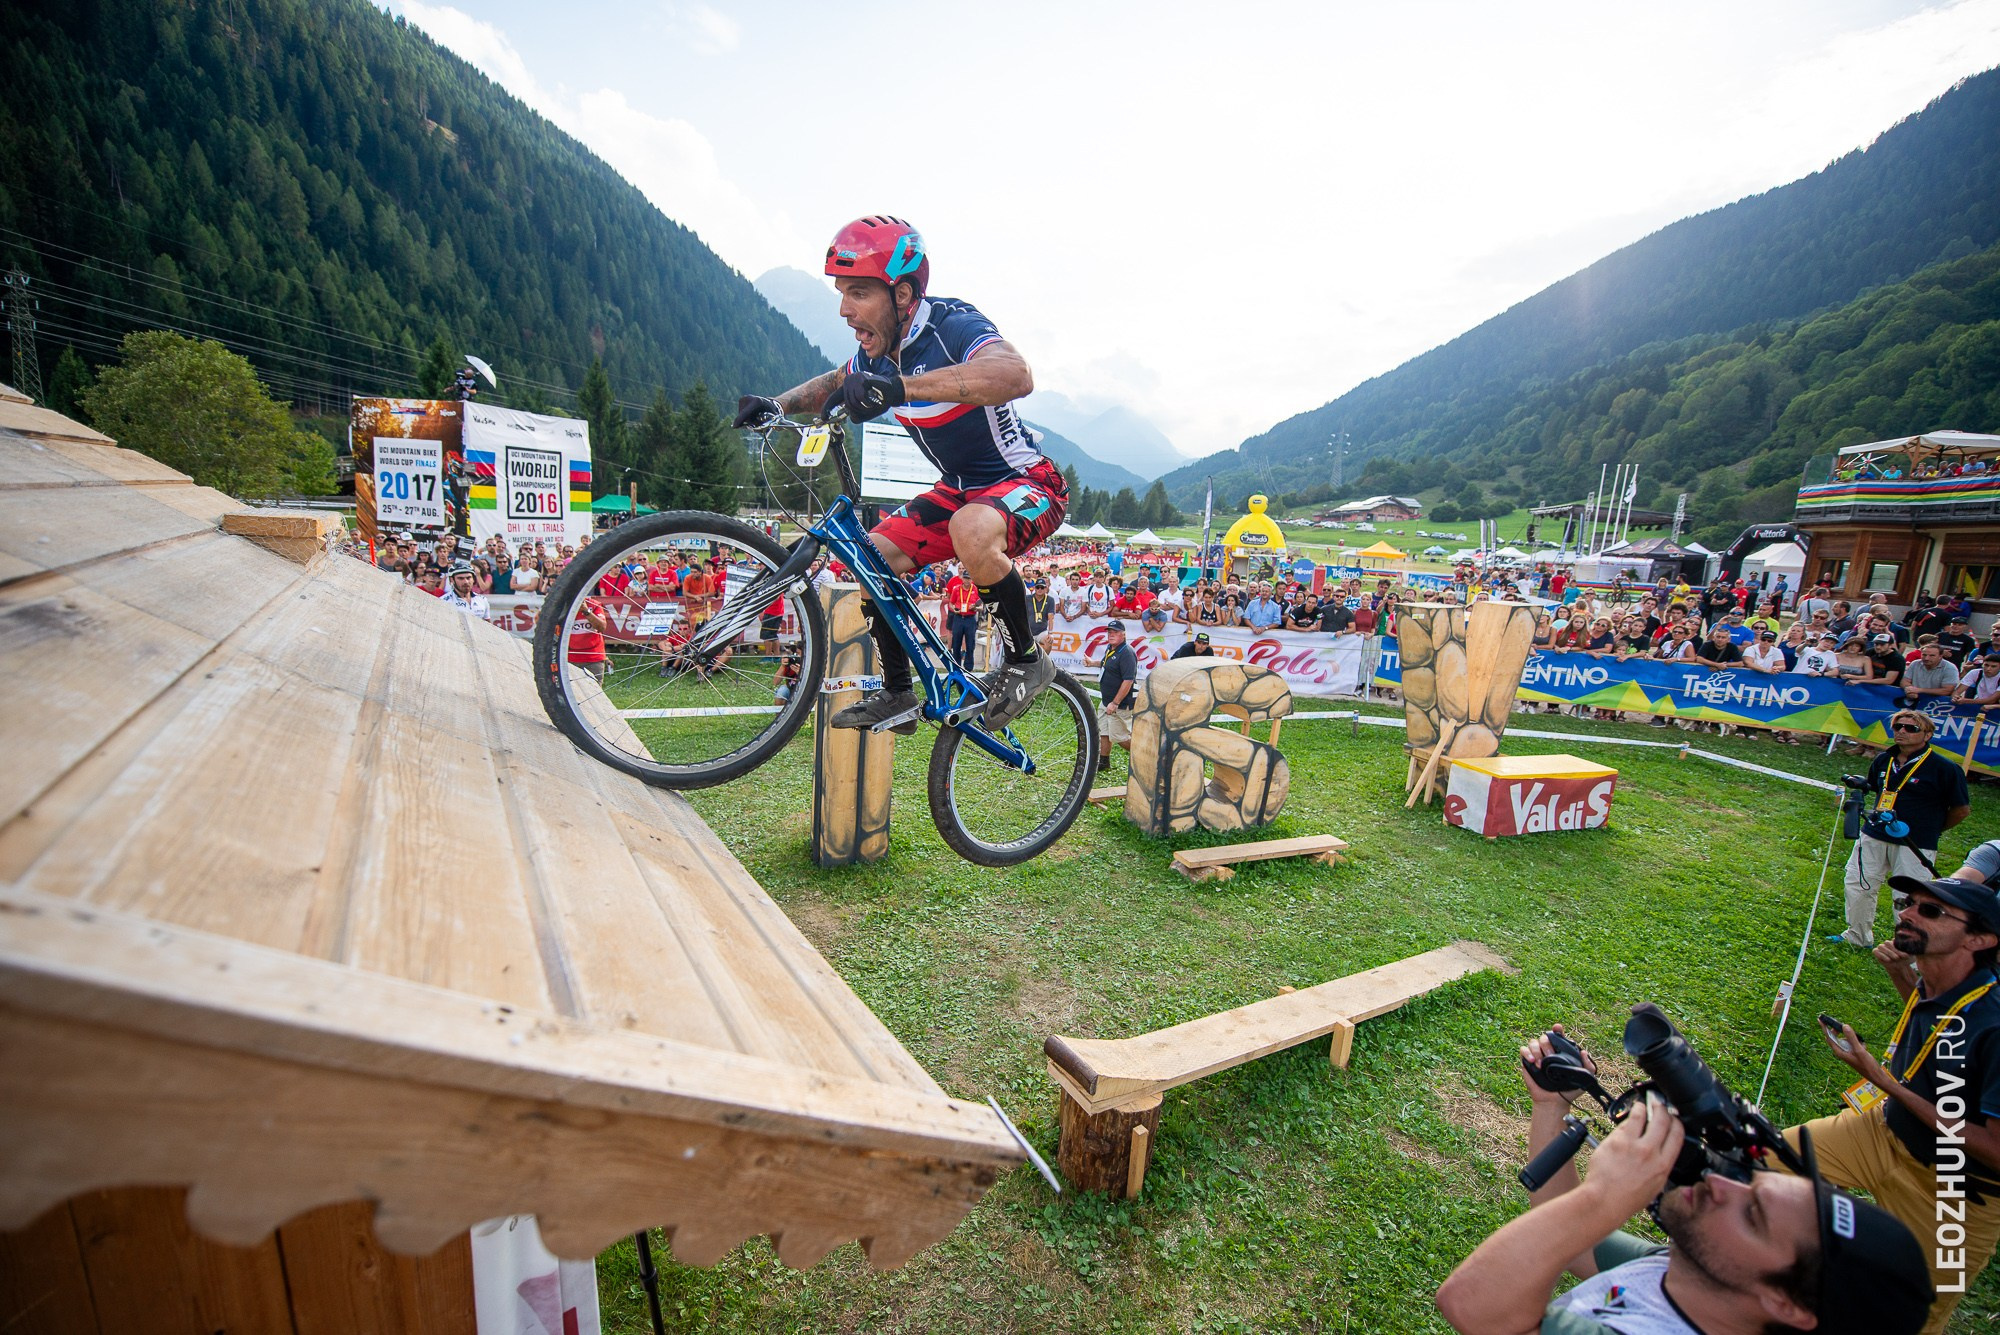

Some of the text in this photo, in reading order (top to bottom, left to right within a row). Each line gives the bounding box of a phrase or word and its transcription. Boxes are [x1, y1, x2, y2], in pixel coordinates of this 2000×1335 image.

[390, 447, 421, 456] MOUNTAIN
[423, 449, 437, 457] BIKE
[811, 437, 819, 453] 1
[379, 457, 400, 466] WORLD
[415, 459, 437, 468] FINALS
[521, 452, 546, 460] MOUNTAIN
[511, 460, 557, 479] WORLD
[379, 471, 437, 502] 2017
[512, 480, 556, 490] CHAMPIONSHIPS
[515, 491, 557, 514] 2016
[542, 523, 565, 532] TRIALS
[1332, 568, 1360, 580] TRENTINO
[1248, 638, 1318, 676] Poli
[838, 680, 857, 690] Sole
[1682, 673, 1810, 710] TRENTINO
[1510, 782, 1560, 835] Val
[1559, 800, 1585, 831] di
